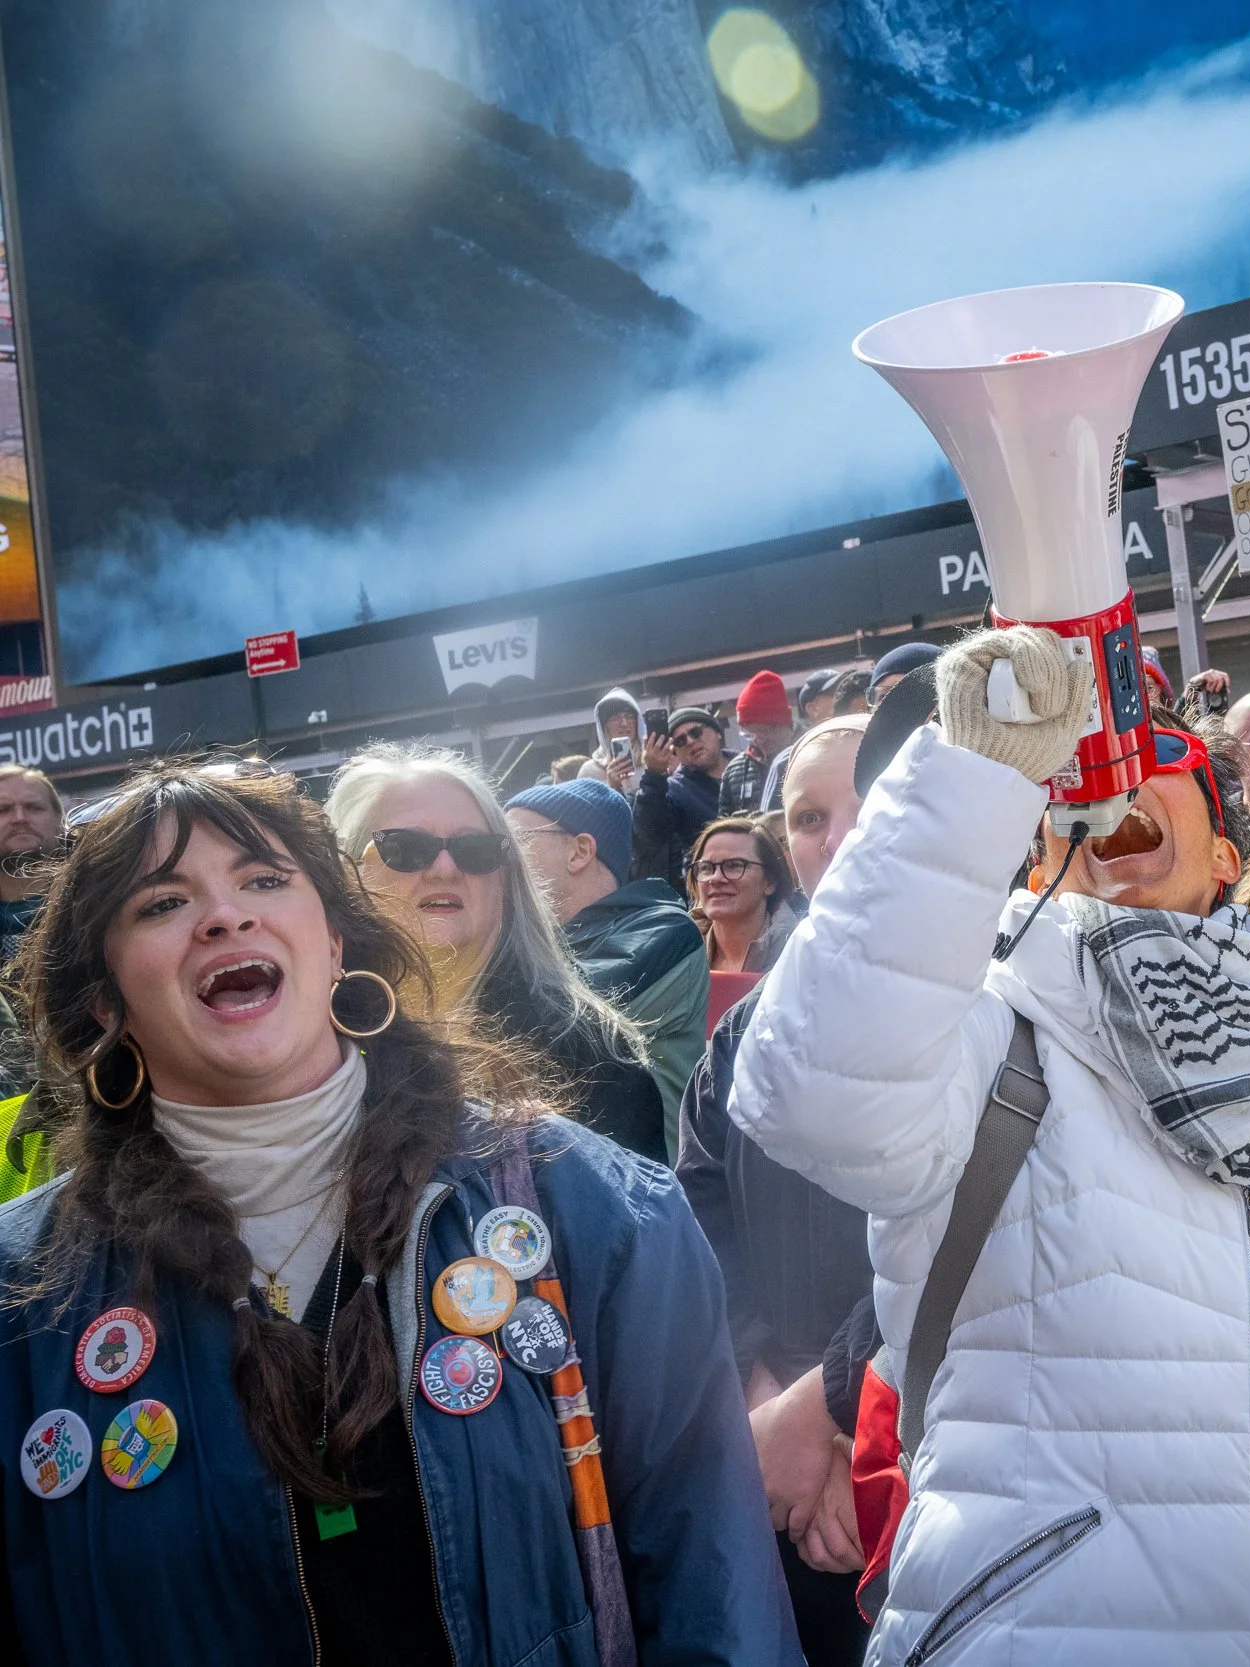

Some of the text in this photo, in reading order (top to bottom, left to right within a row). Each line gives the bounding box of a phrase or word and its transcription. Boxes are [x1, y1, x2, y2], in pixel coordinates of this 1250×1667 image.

[1107, 432, 1125, 517] PALESTINE
[0, 705, 126, 767] swatch
[490, 1211, 508, 1225] EASY
[507, 1260, 537, 1273] LECTRIC
[507, 1320, 537, 1364] NYC
[539, 1322, 559, 1349] OFF
[541, 1304, 567, 1345] HANDS
[76, 1329, 97, 1388] DEMOCRATIC
[121, 1343, 151, 1385] AMERICA
[425, 1345, 496, 1409] FIGHT FASCISM
[25, 1438, 44, 1460] WE
[55, 1427, 72, 1468] OFF
[60, 1449, 84, 1482] NYC
